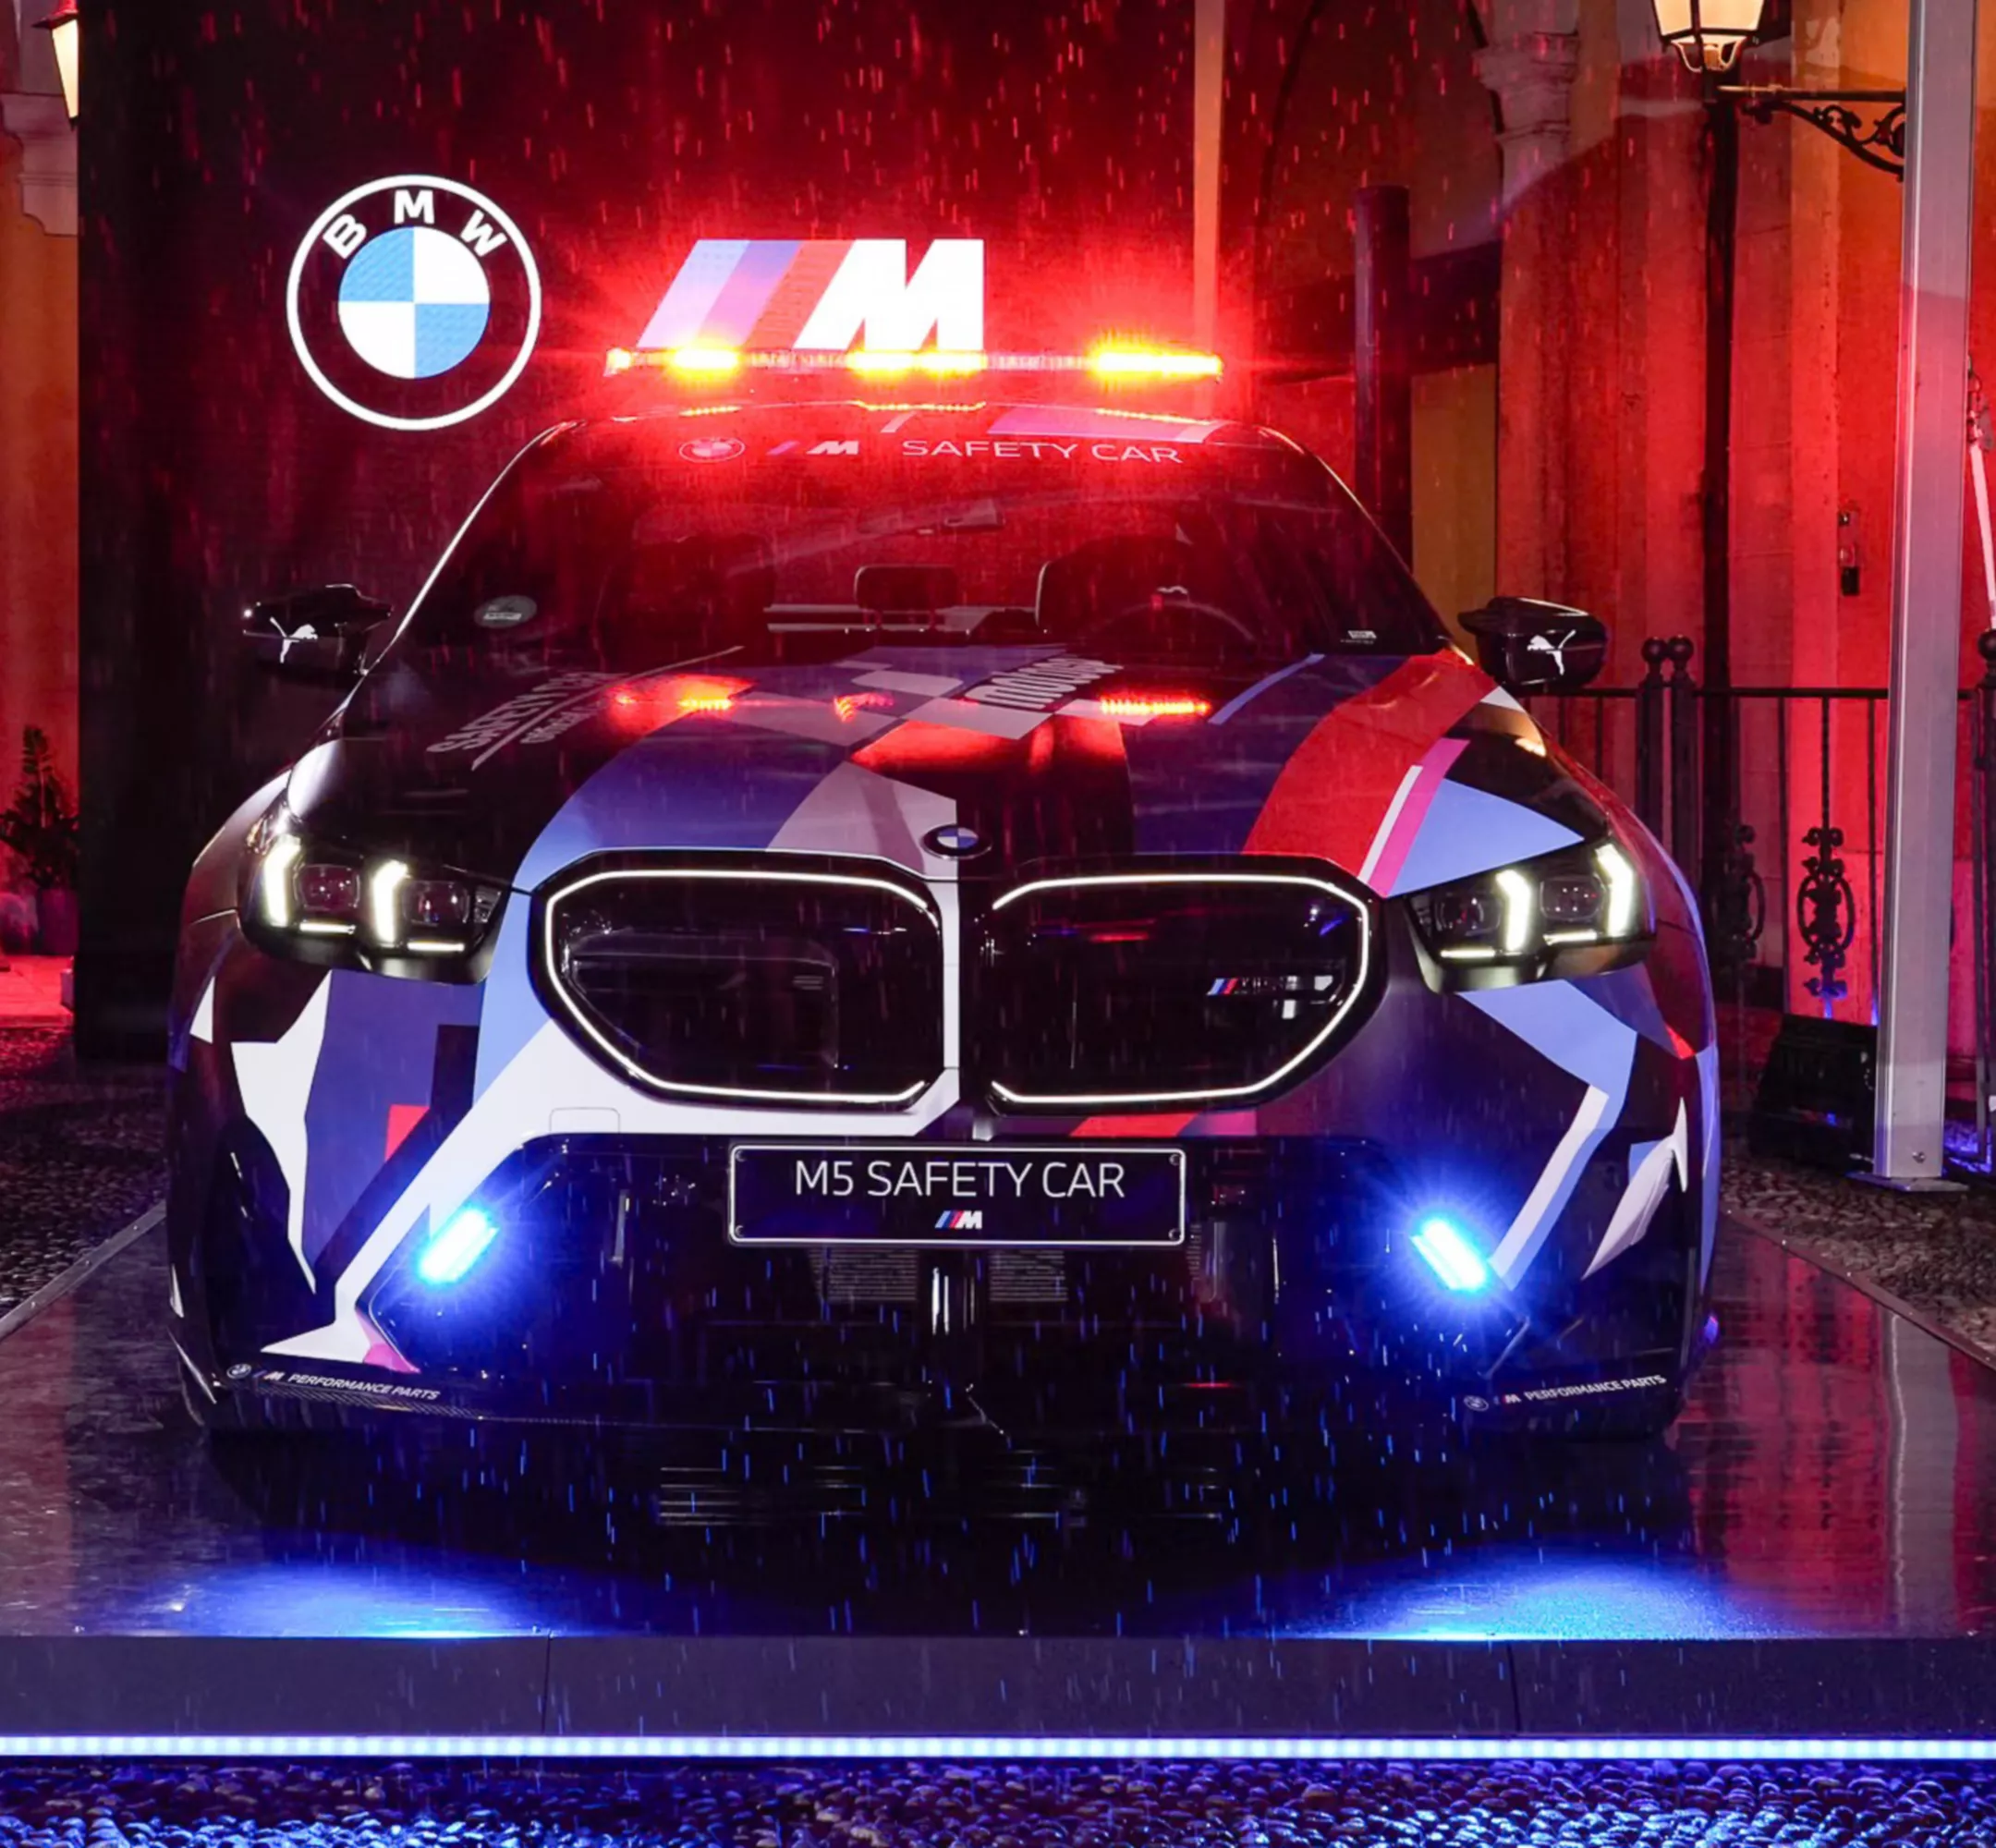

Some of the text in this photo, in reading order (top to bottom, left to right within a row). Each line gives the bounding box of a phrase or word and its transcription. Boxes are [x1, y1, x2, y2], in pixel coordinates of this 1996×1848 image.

[323, 189, 507, 259] BMW
[902, 440, 1078, 459] SAFETY
[1090, 443, 1184, 464] CAR
[796, 1161, 1126, 1198] M5 SAFETY CAR
[287, 1373, 393, 1395] PERFORMANCE
[391, 1387, 441, 1401] PARTS
[1524, 1380, 1622, 1402] PERFORMANCE
[1622, 1373, 1667, 1391] PARTS
